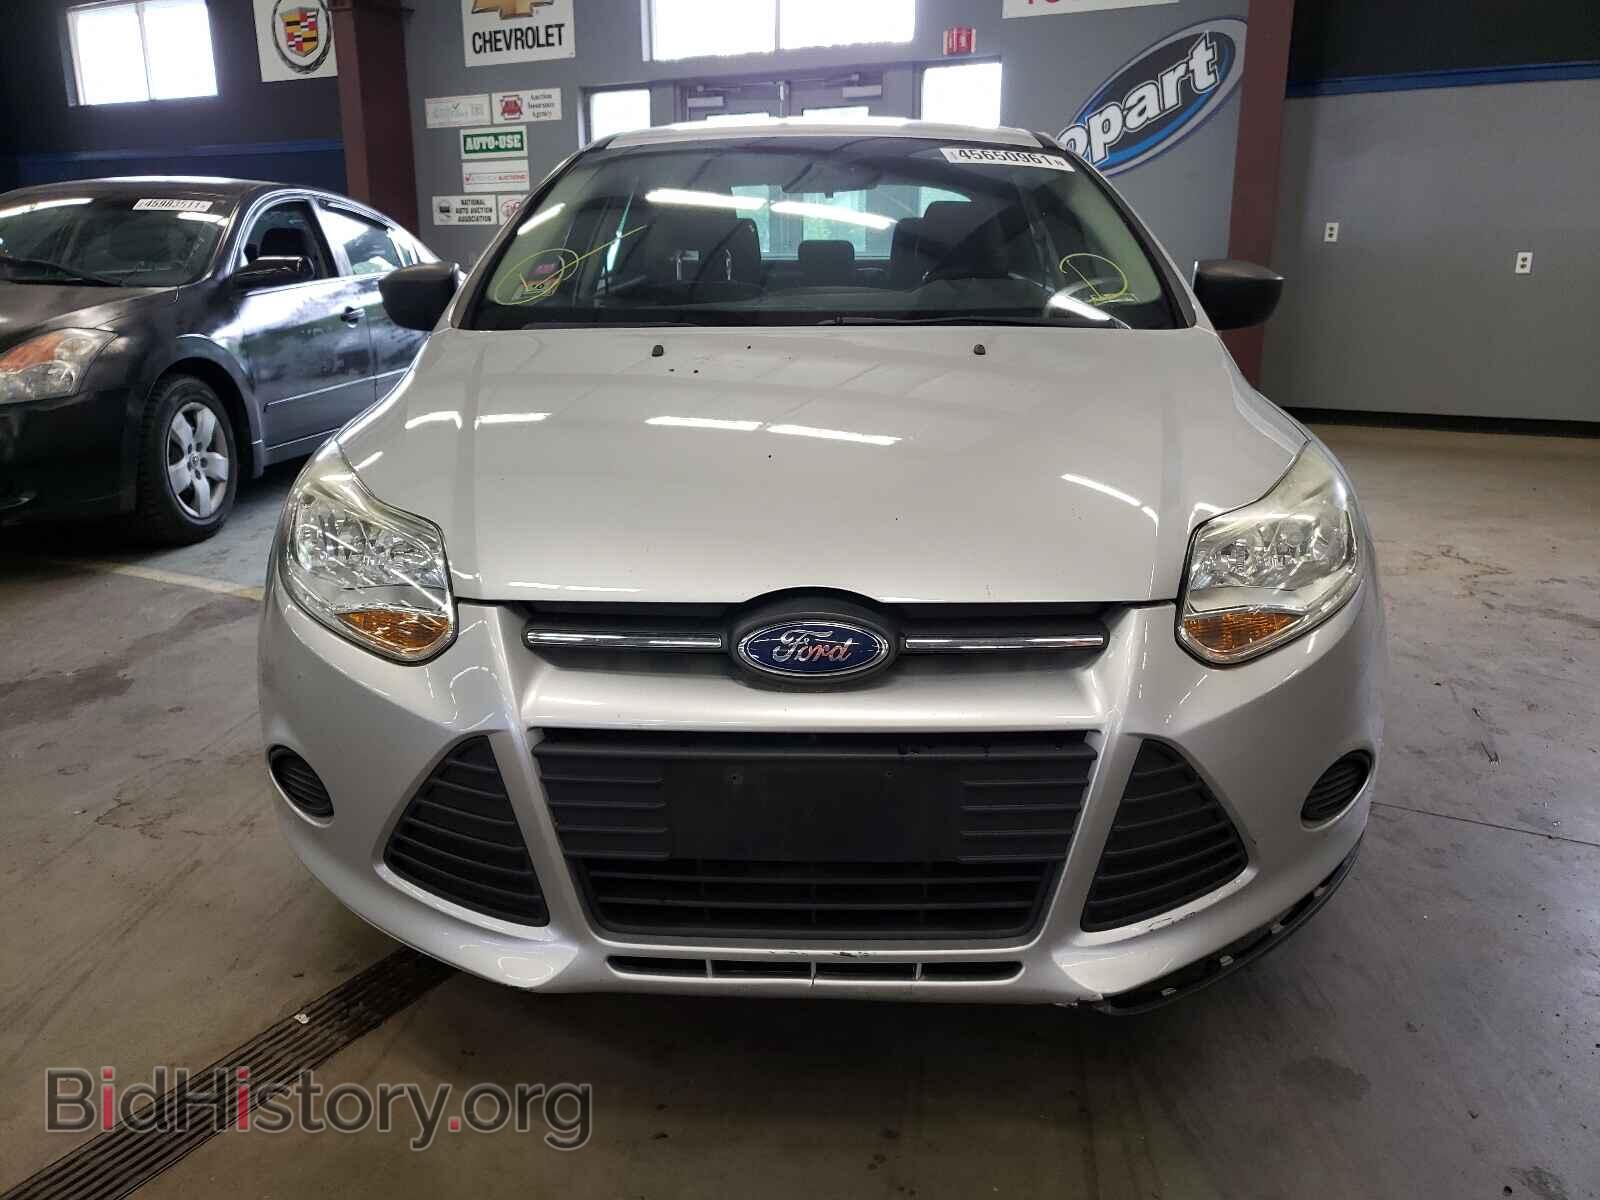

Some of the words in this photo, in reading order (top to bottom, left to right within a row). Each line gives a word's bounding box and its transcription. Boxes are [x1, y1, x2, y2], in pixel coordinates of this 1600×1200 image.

[472, 23, 565, 54] CHEVROLET
[1057, 30, 1220, 166] opart
[958, 149, 1053, 166] 45650961
[458, 215, 492, 223] ASSOCIATION
[772, 629, 854, 662] Ford
